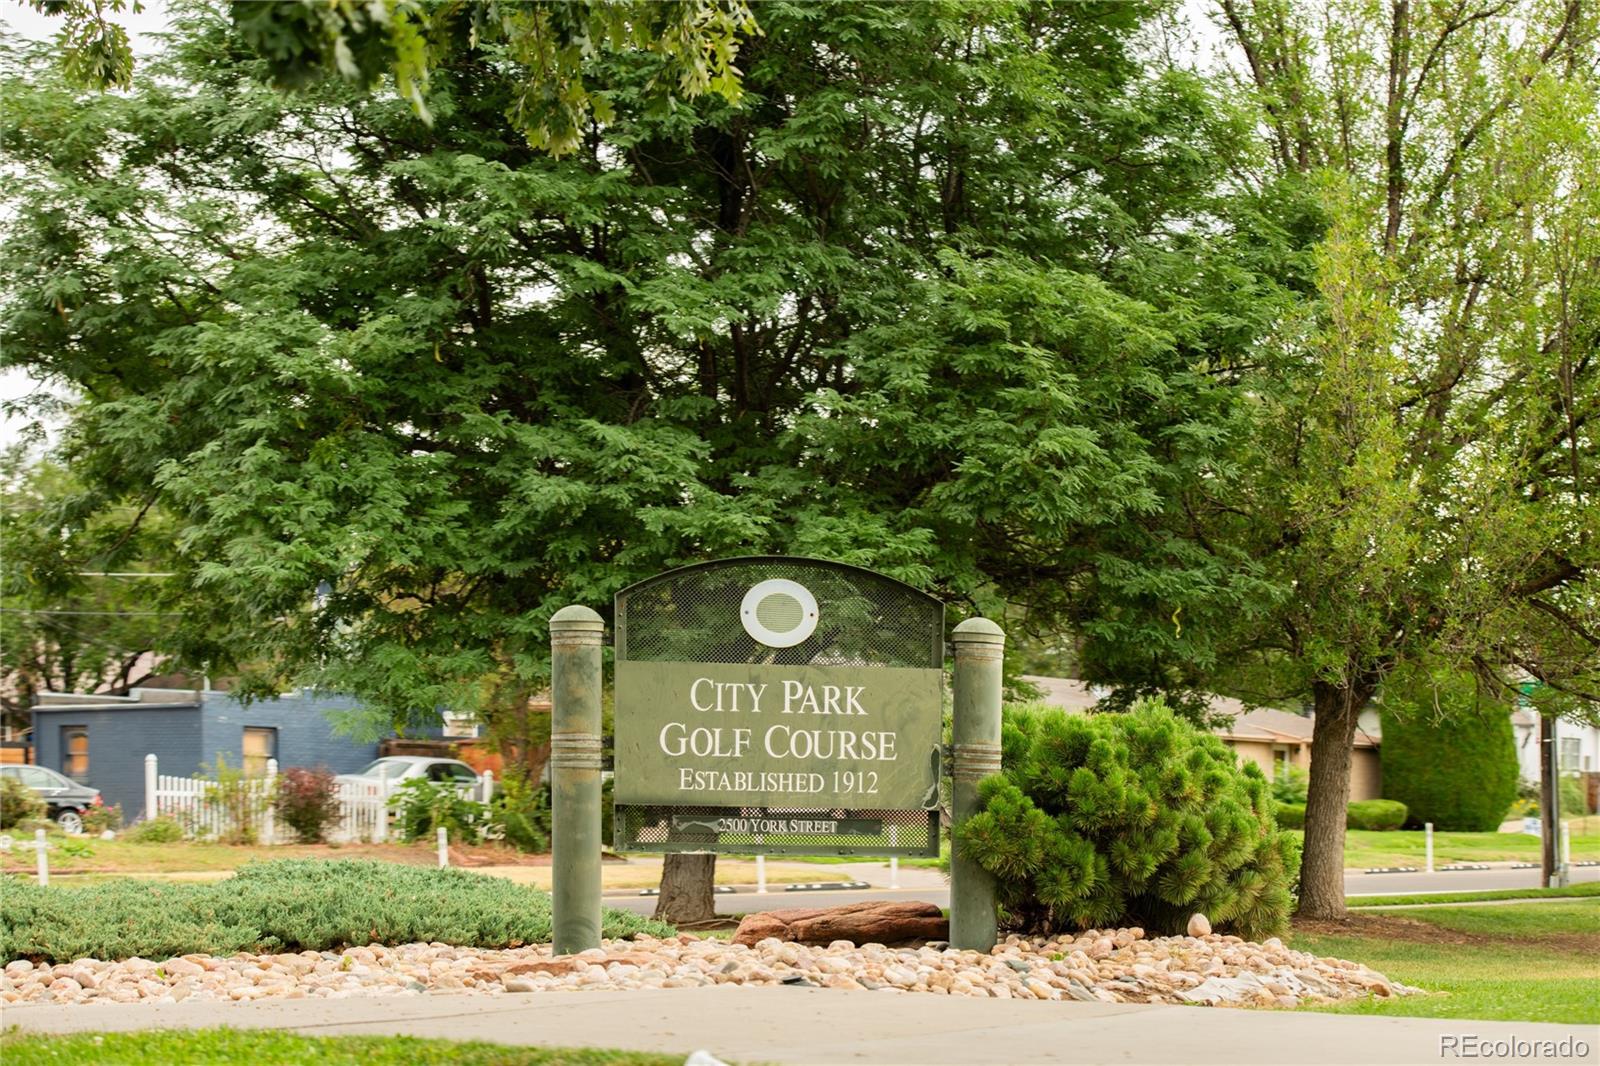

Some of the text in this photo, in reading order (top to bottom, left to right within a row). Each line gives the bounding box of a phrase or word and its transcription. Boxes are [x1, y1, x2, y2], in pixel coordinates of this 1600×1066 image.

[690, 677, 868, 715] CITY PARK
[659, 722, 897, 761] GOLF COURSE
[679, 768, 878, 794] ESTABLISHED 1912
[718, 818, 838, 834] 2500 YORK STREET
